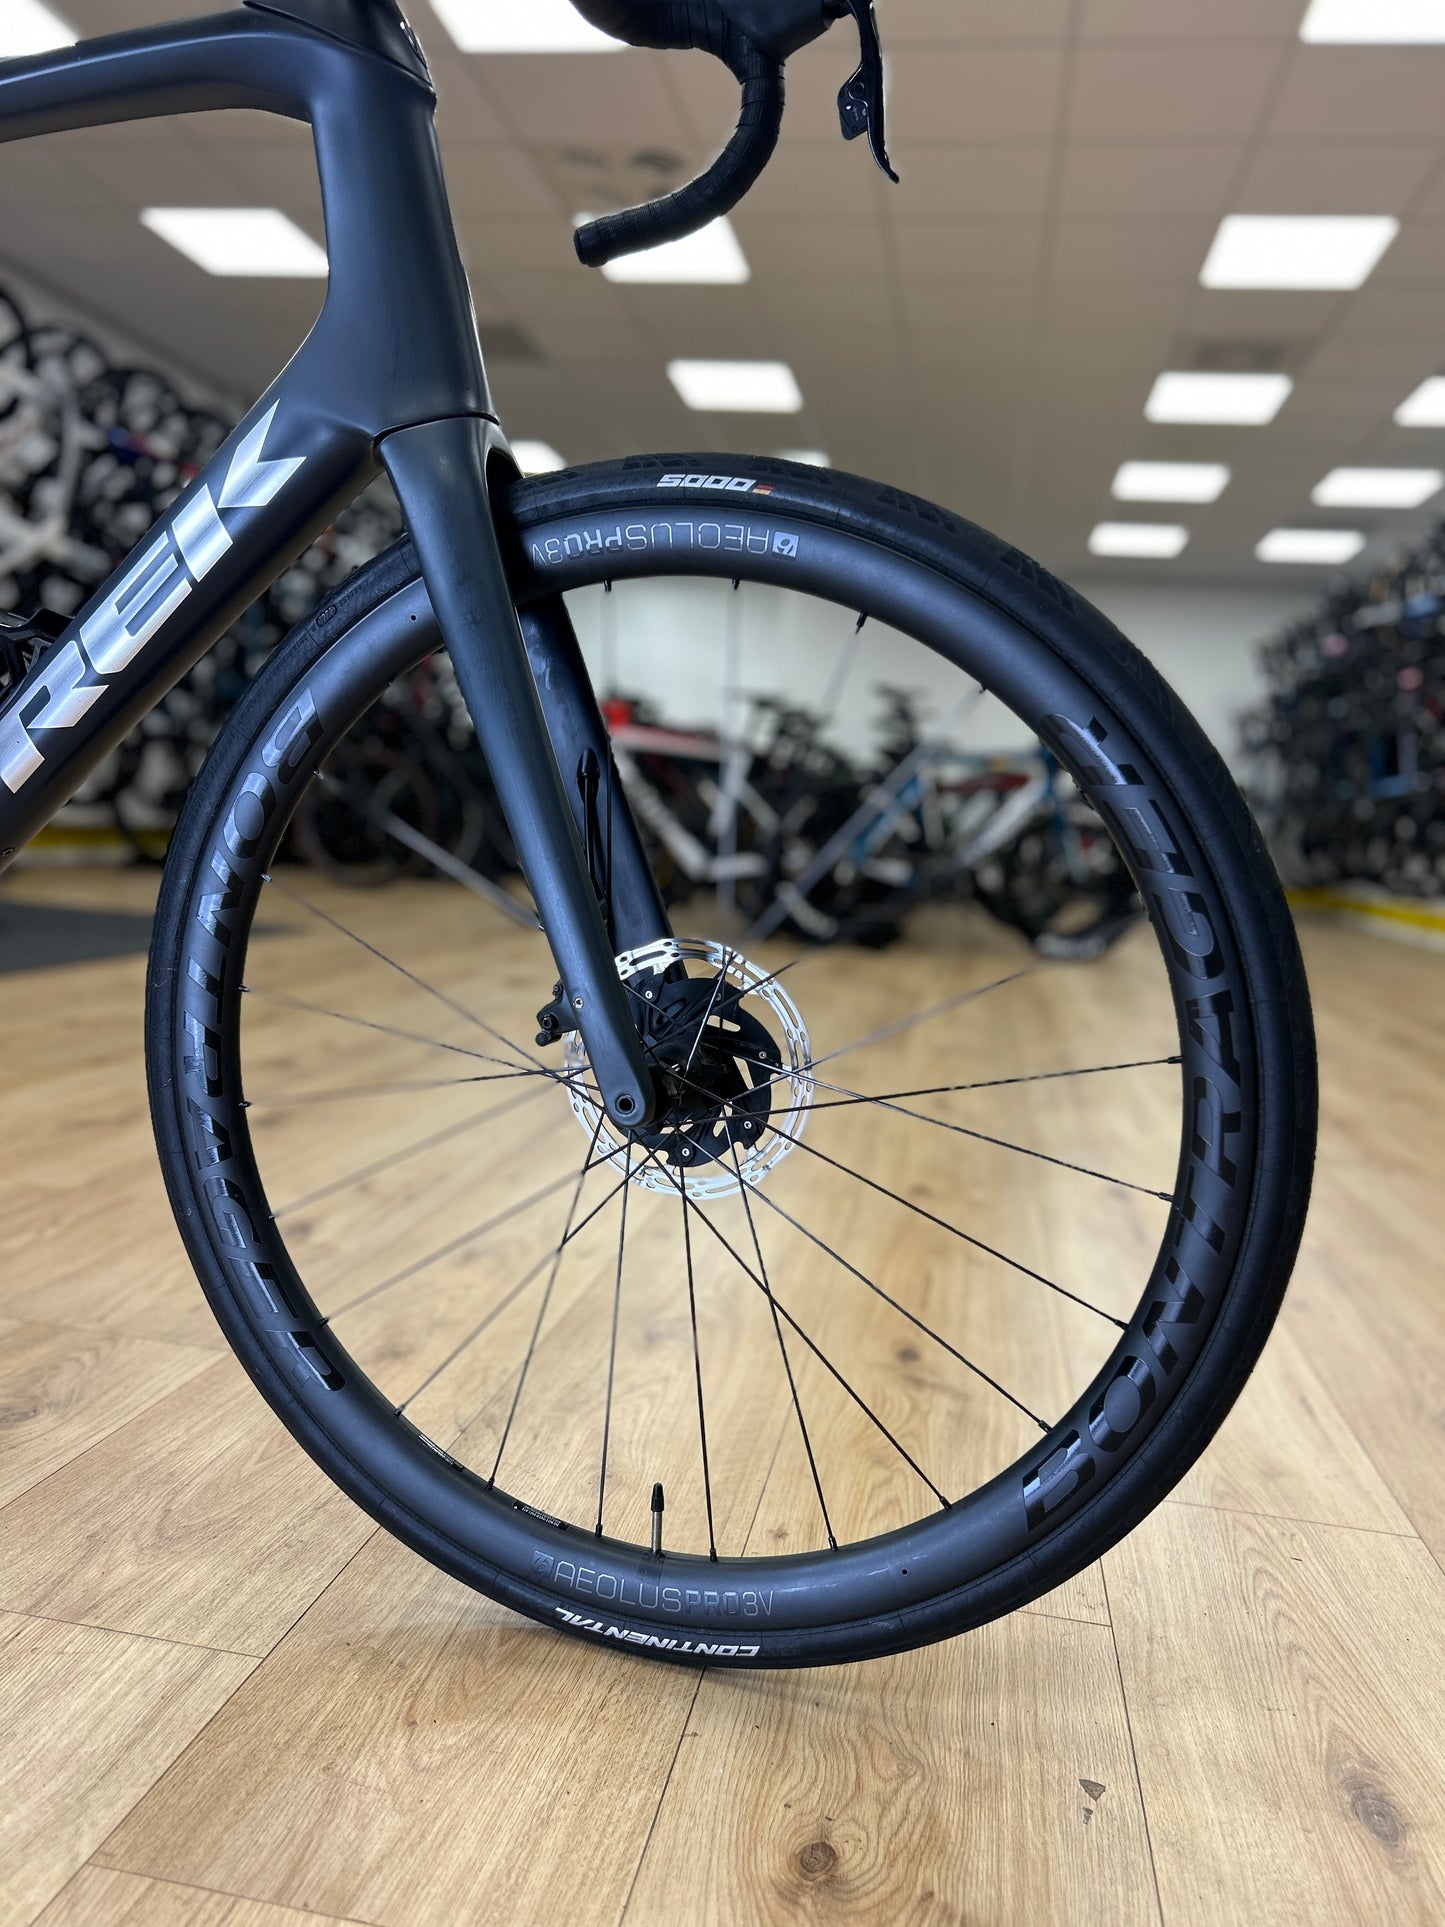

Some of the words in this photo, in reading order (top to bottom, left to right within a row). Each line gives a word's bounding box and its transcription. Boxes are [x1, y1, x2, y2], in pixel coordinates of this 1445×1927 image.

[656, 473, 757, 492] 5000
[184, 688, 346, 1392] BONTRAGER
[1022, 713, 1242, 1533] BONTRAGER
[555, 1606, 760, 1658] CONTINENTAL
